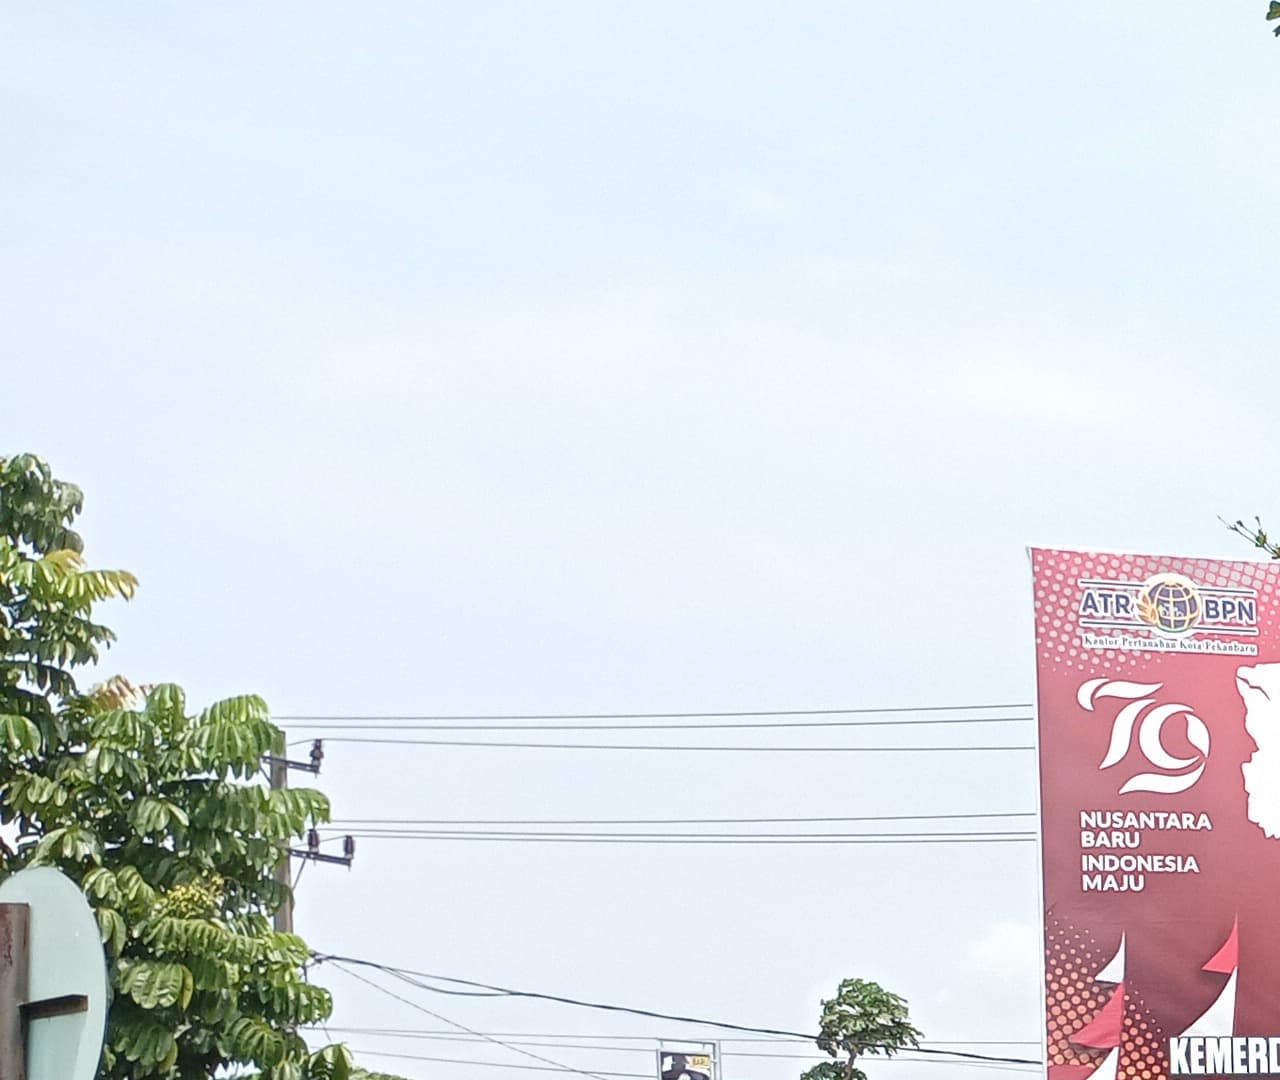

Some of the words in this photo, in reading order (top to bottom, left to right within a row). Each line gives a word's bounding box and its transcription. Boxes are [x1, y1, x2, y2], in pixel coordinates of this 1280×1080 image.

[1082, 592, 1131, 615] ATR
[1205, 599, 1254, 621] BPN
[1085, 636, 1118, 647] Kantor
[1122, 637, 1176, 649] Pertanahan
[1180, 640, 1201, 650] Kota
[1206, 641, 1256, 654] Pekanbaru
[1077, 677, 1211, 795] 79
[1080, 811, 1212, 832] NUSANTARA
[1081, 830, 1140, 848] BARU
[1081, 854, 1200, 874] INDONESIA
[1082, 873, 1145, 892] MAJU
